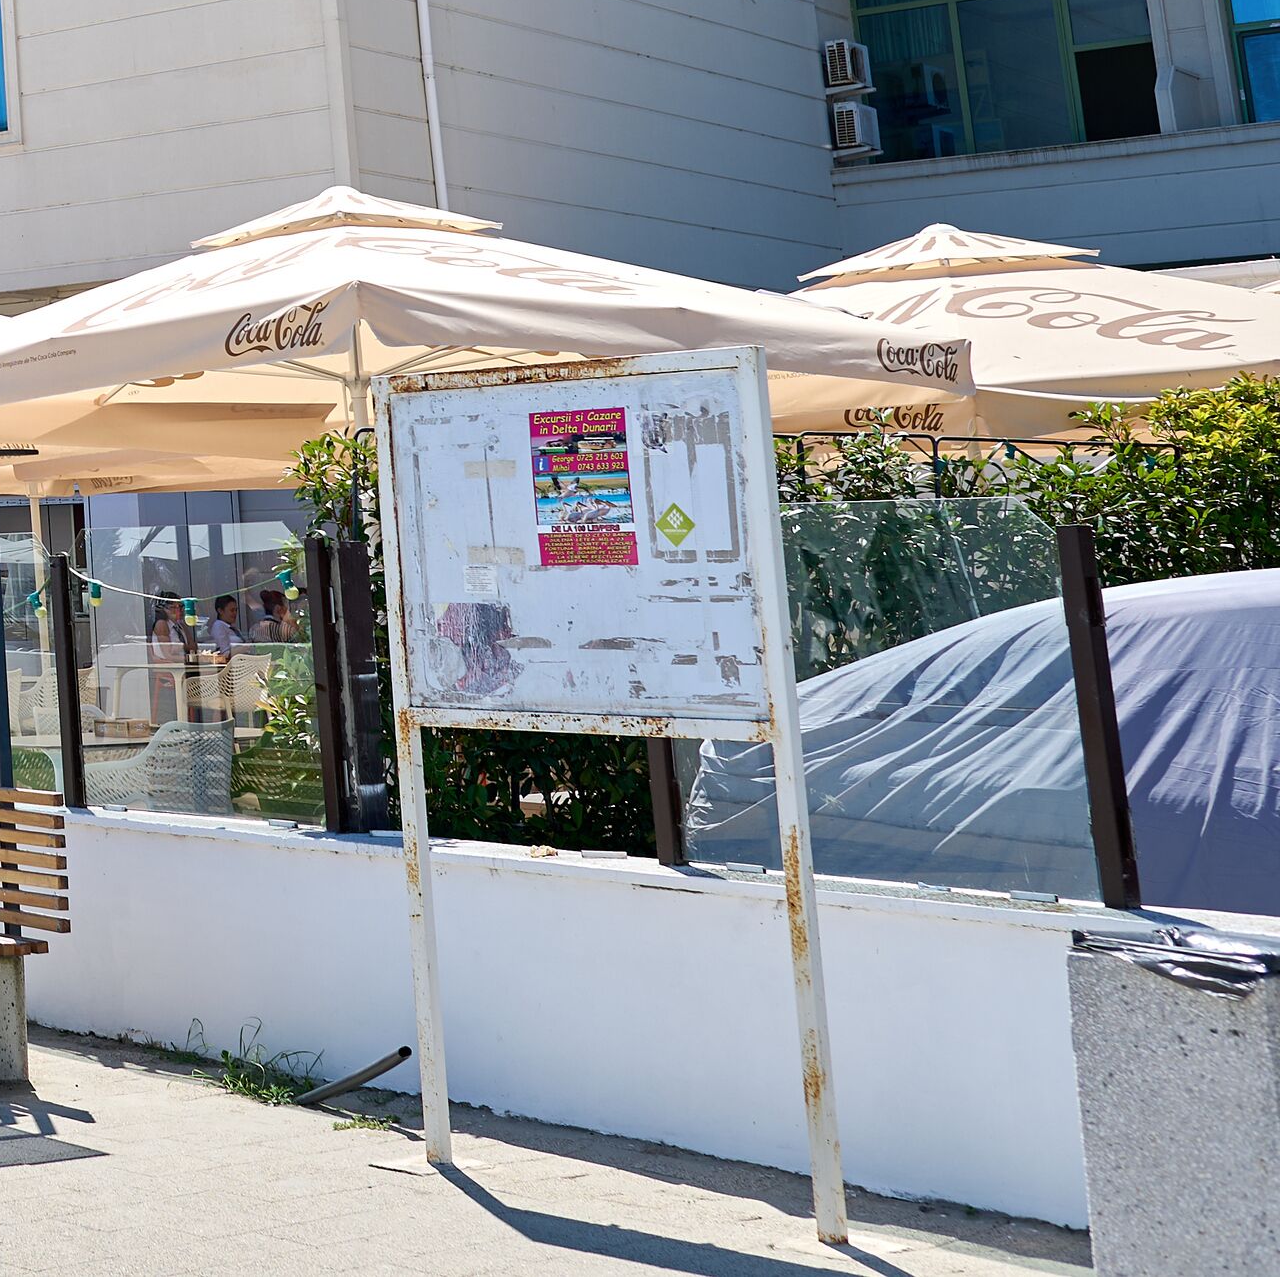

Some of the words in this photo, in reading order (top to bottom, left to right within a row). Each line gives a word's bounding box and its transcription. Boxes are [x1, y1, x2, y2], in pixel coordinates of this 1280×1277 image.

[876, 338, 958, 383] Coca-Cola
[534, 413, 572, 424] Excursii
[575, 413, 583, 422] si
[587, 411, 621, 421] Cazare
[540, 426, 548, 434] in
[552, 424, 577, 434] Delta
[582, 422, 617, 433] Dunarii
[552, 455, 575, 463] George
[595, 453, 608, 461] 215
[577, 463, 594, 471] 0743
